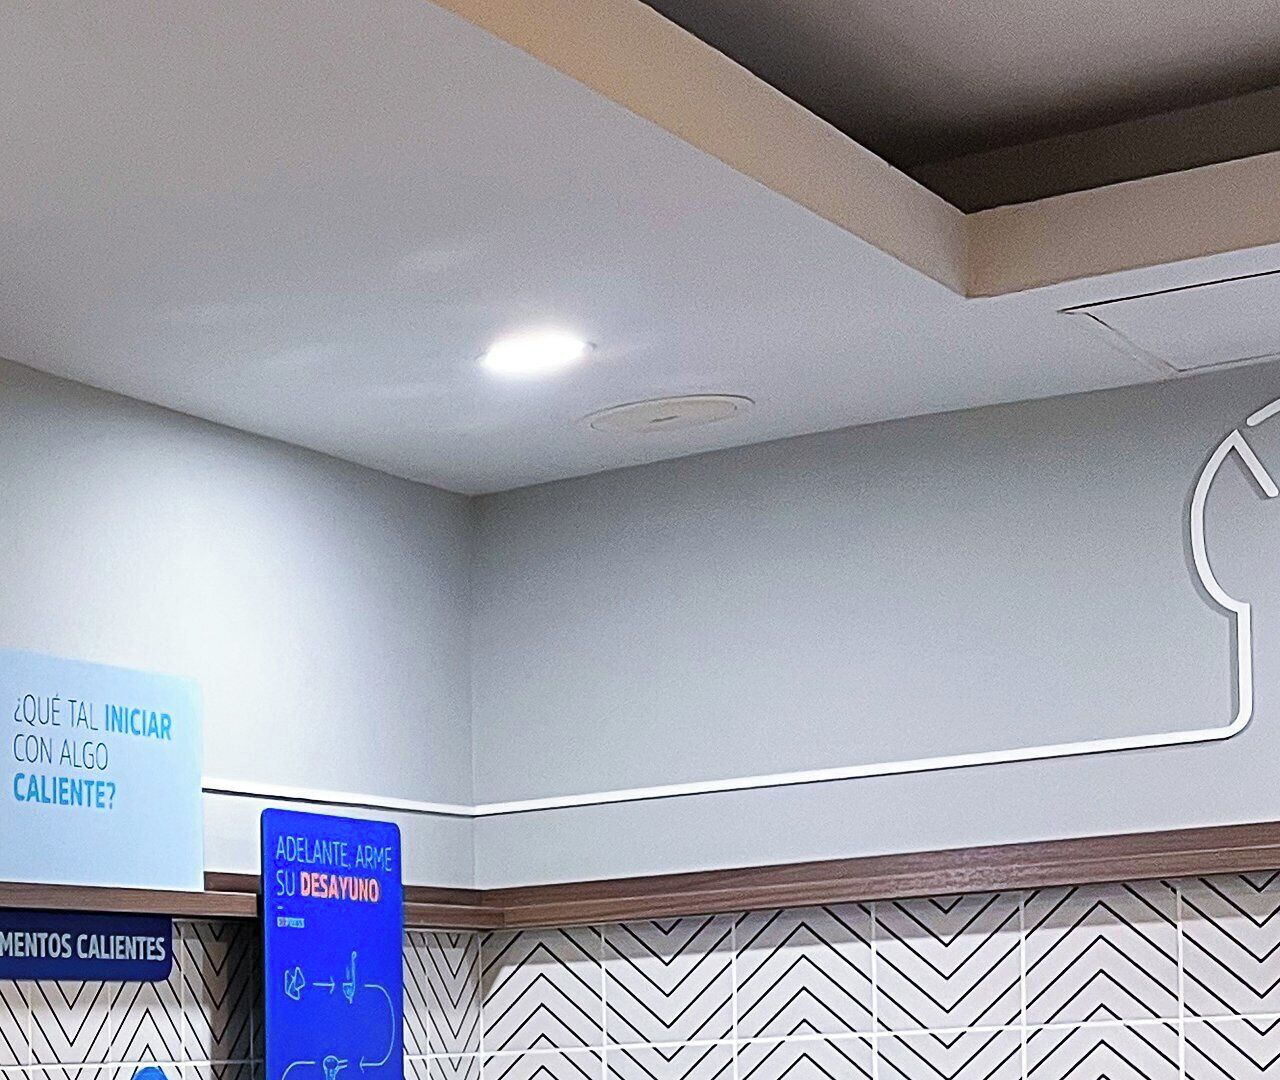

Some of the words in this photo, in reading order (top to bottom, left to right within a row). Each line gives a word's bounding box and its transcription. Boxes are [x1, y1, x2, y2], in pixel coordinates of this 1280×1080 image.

[13, 693, 61, 726] ¿QUÉ
[67, 699, 99, 731] TAL
[105, 704, 172, 741] INICIAR
[13, 733, 52, 764] CON
[60, 738, 109, 771] ALGO
[13, 772, 117, 810] CALIENTE?
[275, 835, 352, 870] ADELANTE,
[355, 844, 392, 872] ARME
[276, 869, 295, 897] SU
[300, 871, 380, 903] DESAYUNO
[76, 933, 167, 961] CALIENTES
